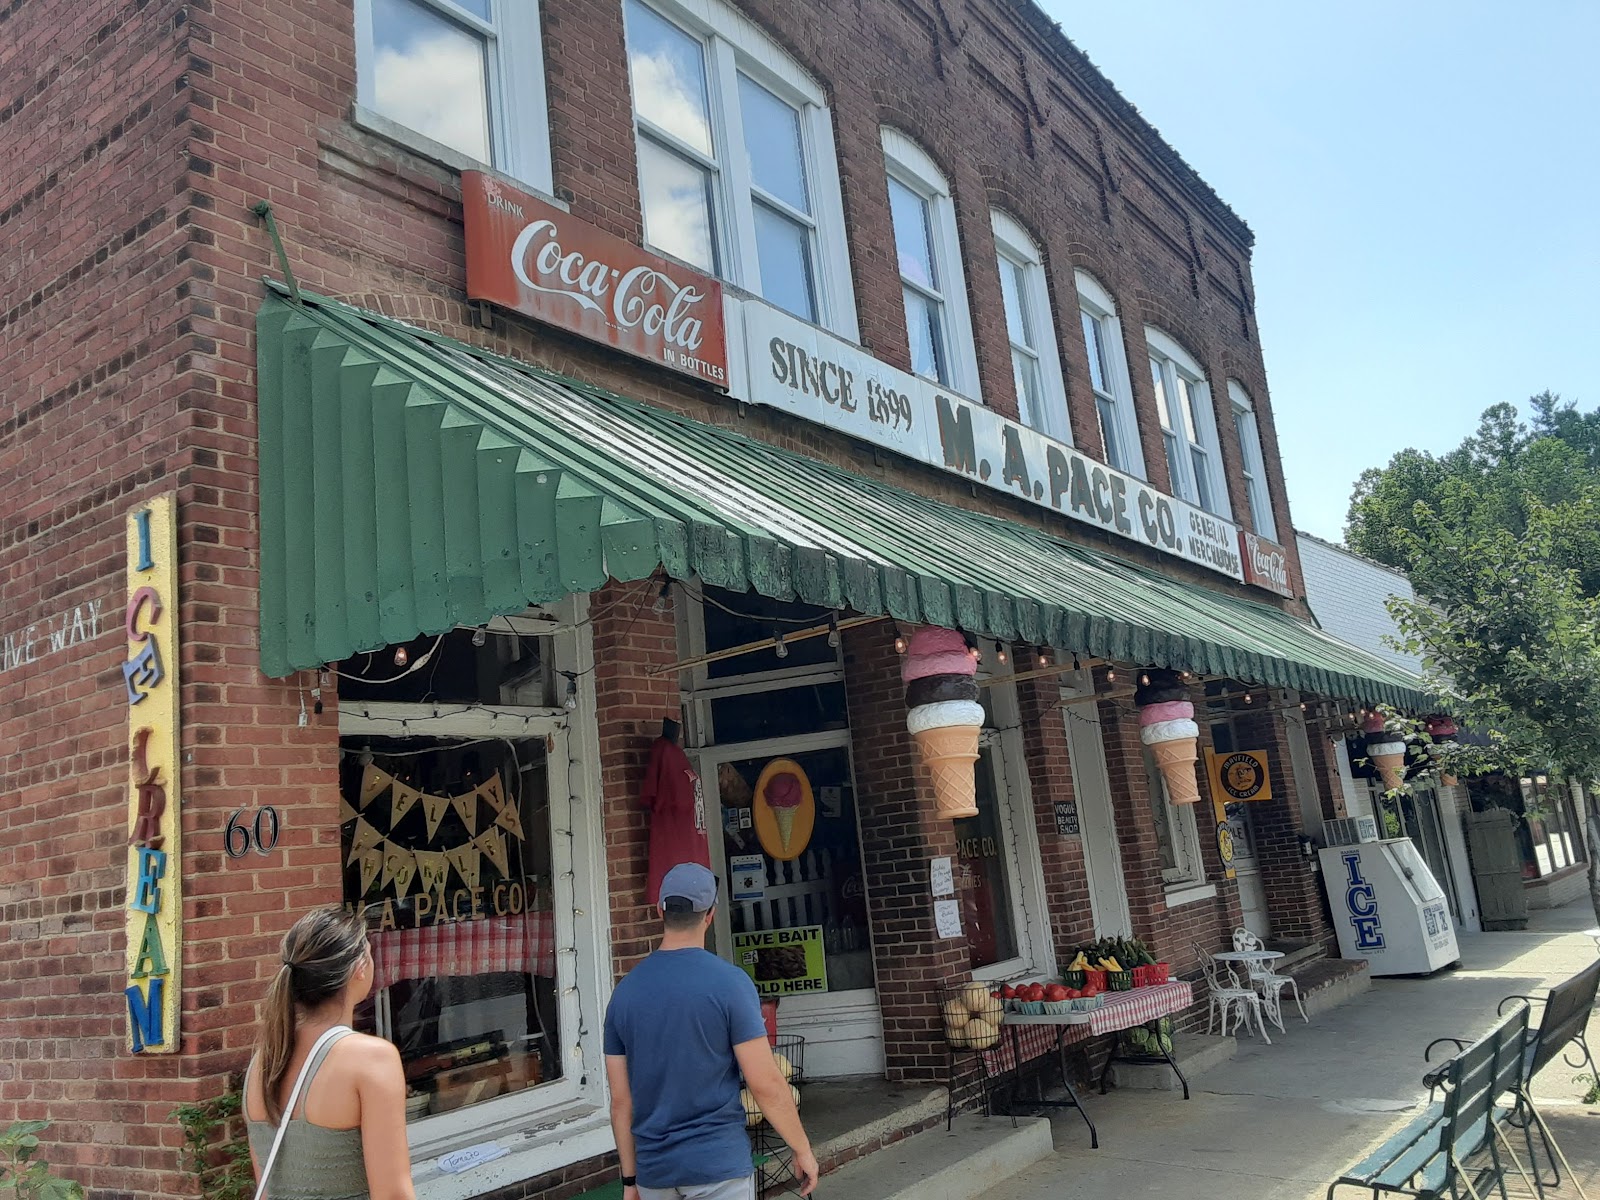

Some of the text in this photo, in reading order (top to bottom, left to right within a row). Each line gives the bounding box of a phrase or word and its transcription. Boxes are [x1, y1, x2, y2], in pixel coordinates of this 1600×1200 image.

[486, 192, 525, 219] DRINK
[511, 219, 706, 351] Coca-Cola
[663, 347, 724, 380] IN BOTTLES
[769, 336, 912, 432] SINCE 1899
[935, 394, 1183, 552] M. A. PACE CO.
[48, 598, 102, 654] WAY
[123, 510, 166, 705] ICE
[224, 805, 280, 858] 60
[1055, 804, 1076, 815] VOGUE
[1060, 824, 1079, 834] SHOP
[415, 885, 486, 928] PACE
[1341, 853, 1386, 951] ICE
[735, 928, 819, 948] LIVE BAIT
[754, 978, 823, 994] OLD HERE
